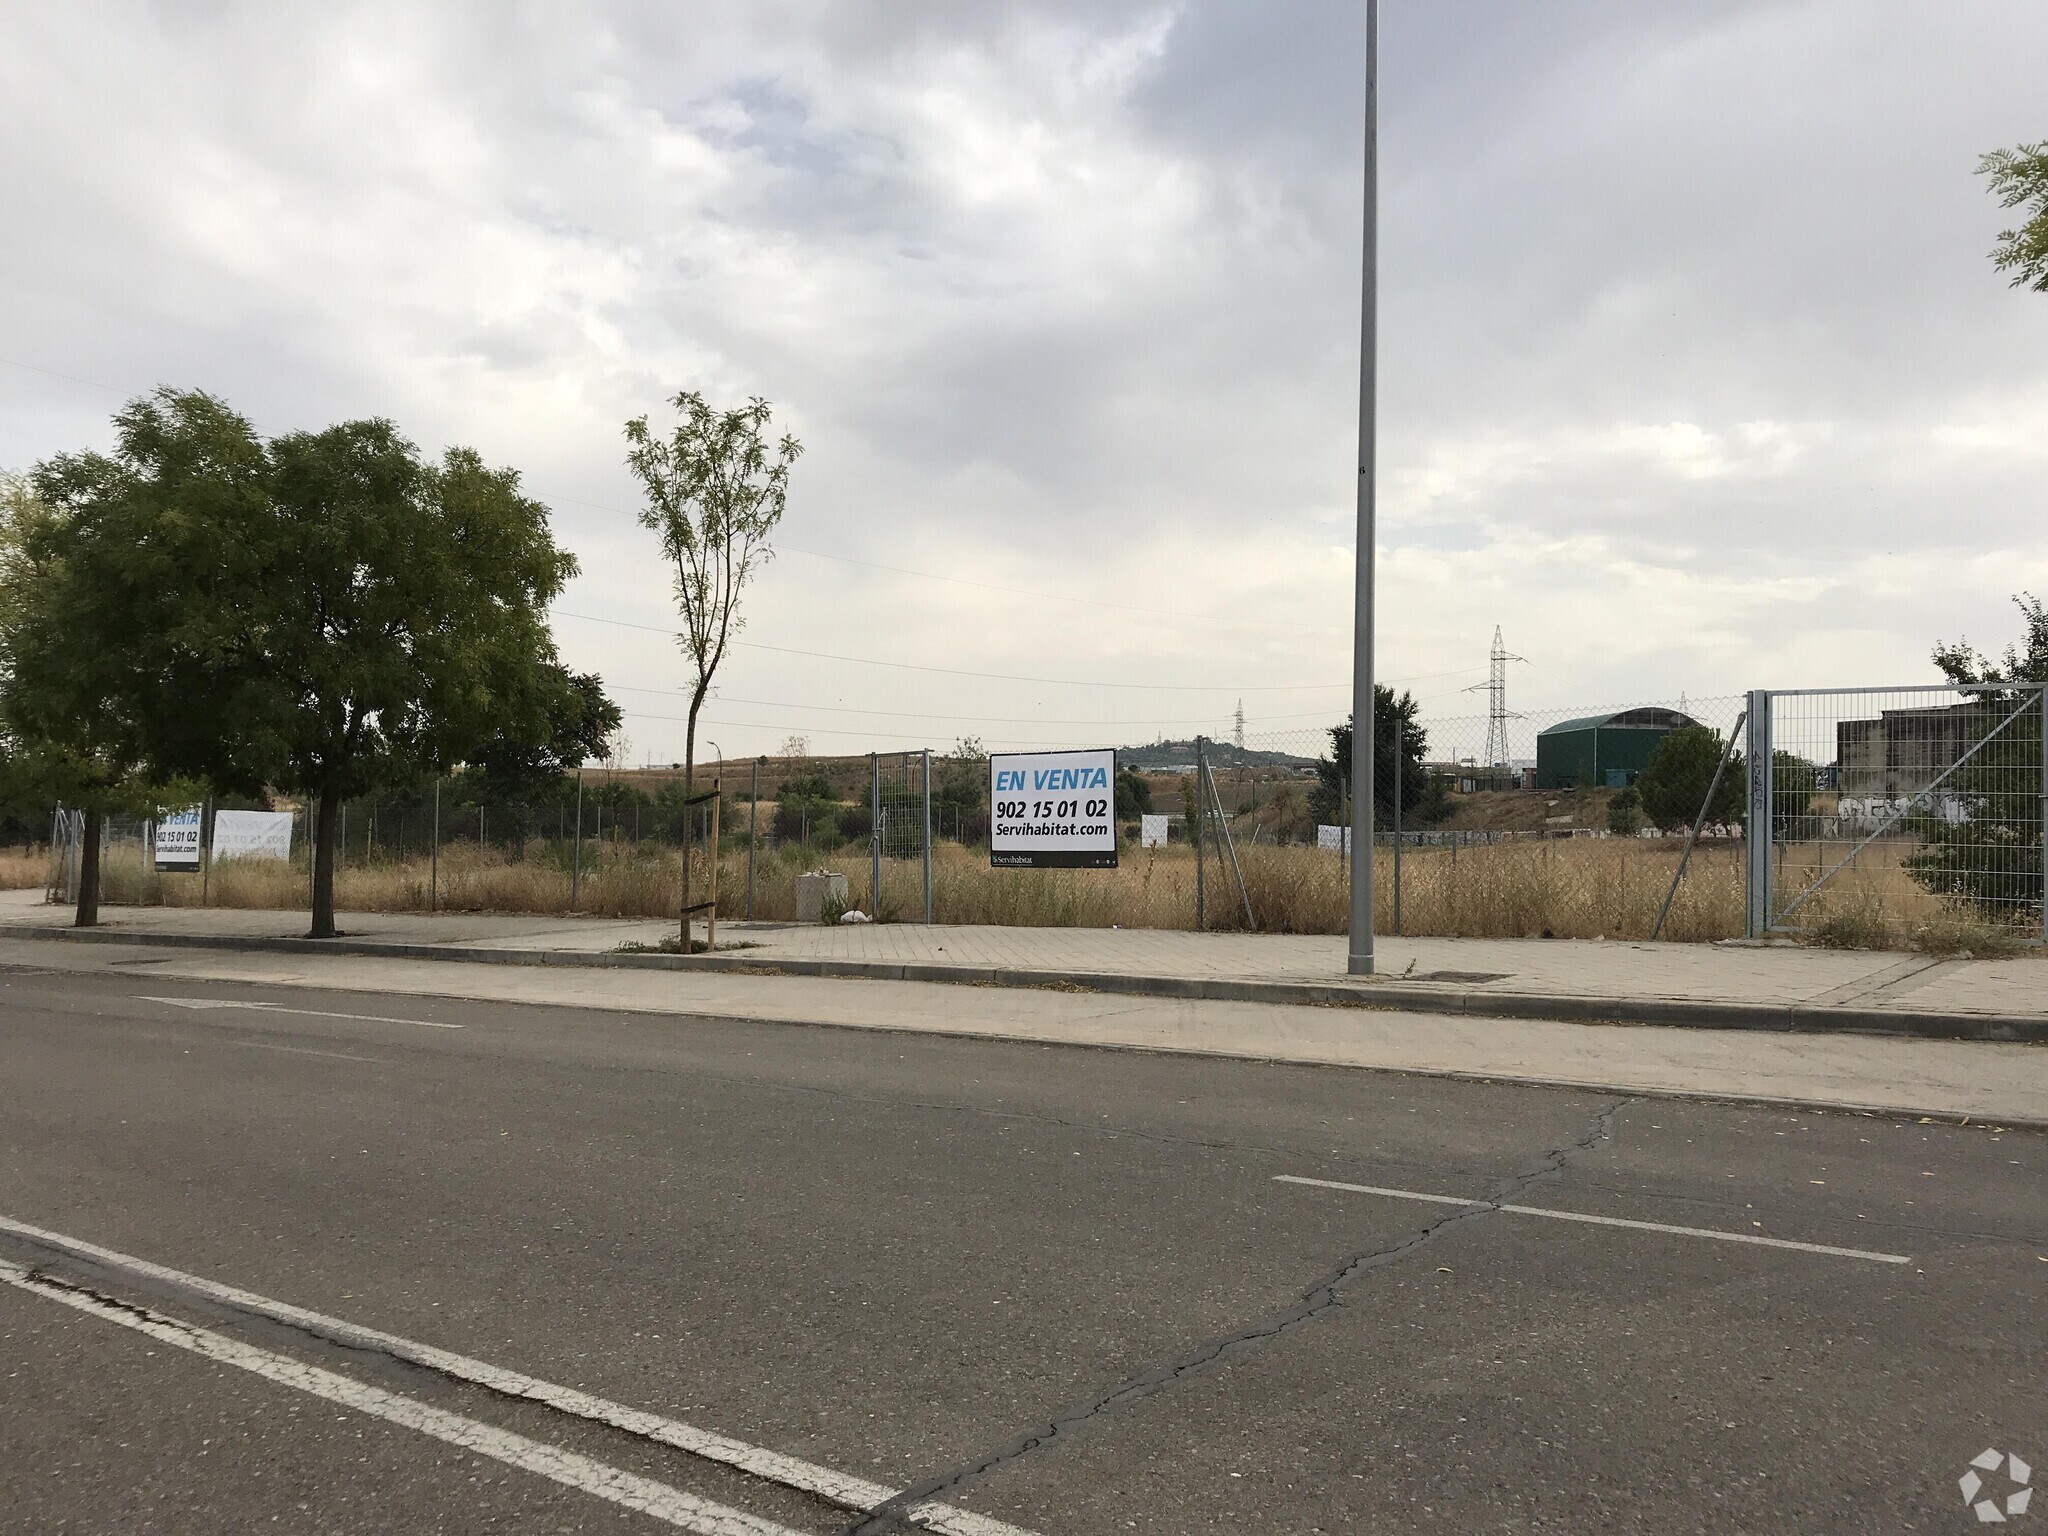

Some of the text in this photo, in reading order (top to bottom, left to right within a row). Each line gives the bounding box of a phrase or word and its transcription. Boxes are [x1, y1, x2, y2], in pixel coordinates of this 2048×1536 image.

[996, 767, 1107, 791] EN VENTA
[996, 799, 1107, 818] 902 15 01 02
[996, 823, 1108, 836] Servihabitat.com
[167, 831, 176, 842] 15
[176, 831, 185, 842] 01
[187, 831, 198, 842] 02
[997, 855, 1033, 864] Servihabitat
